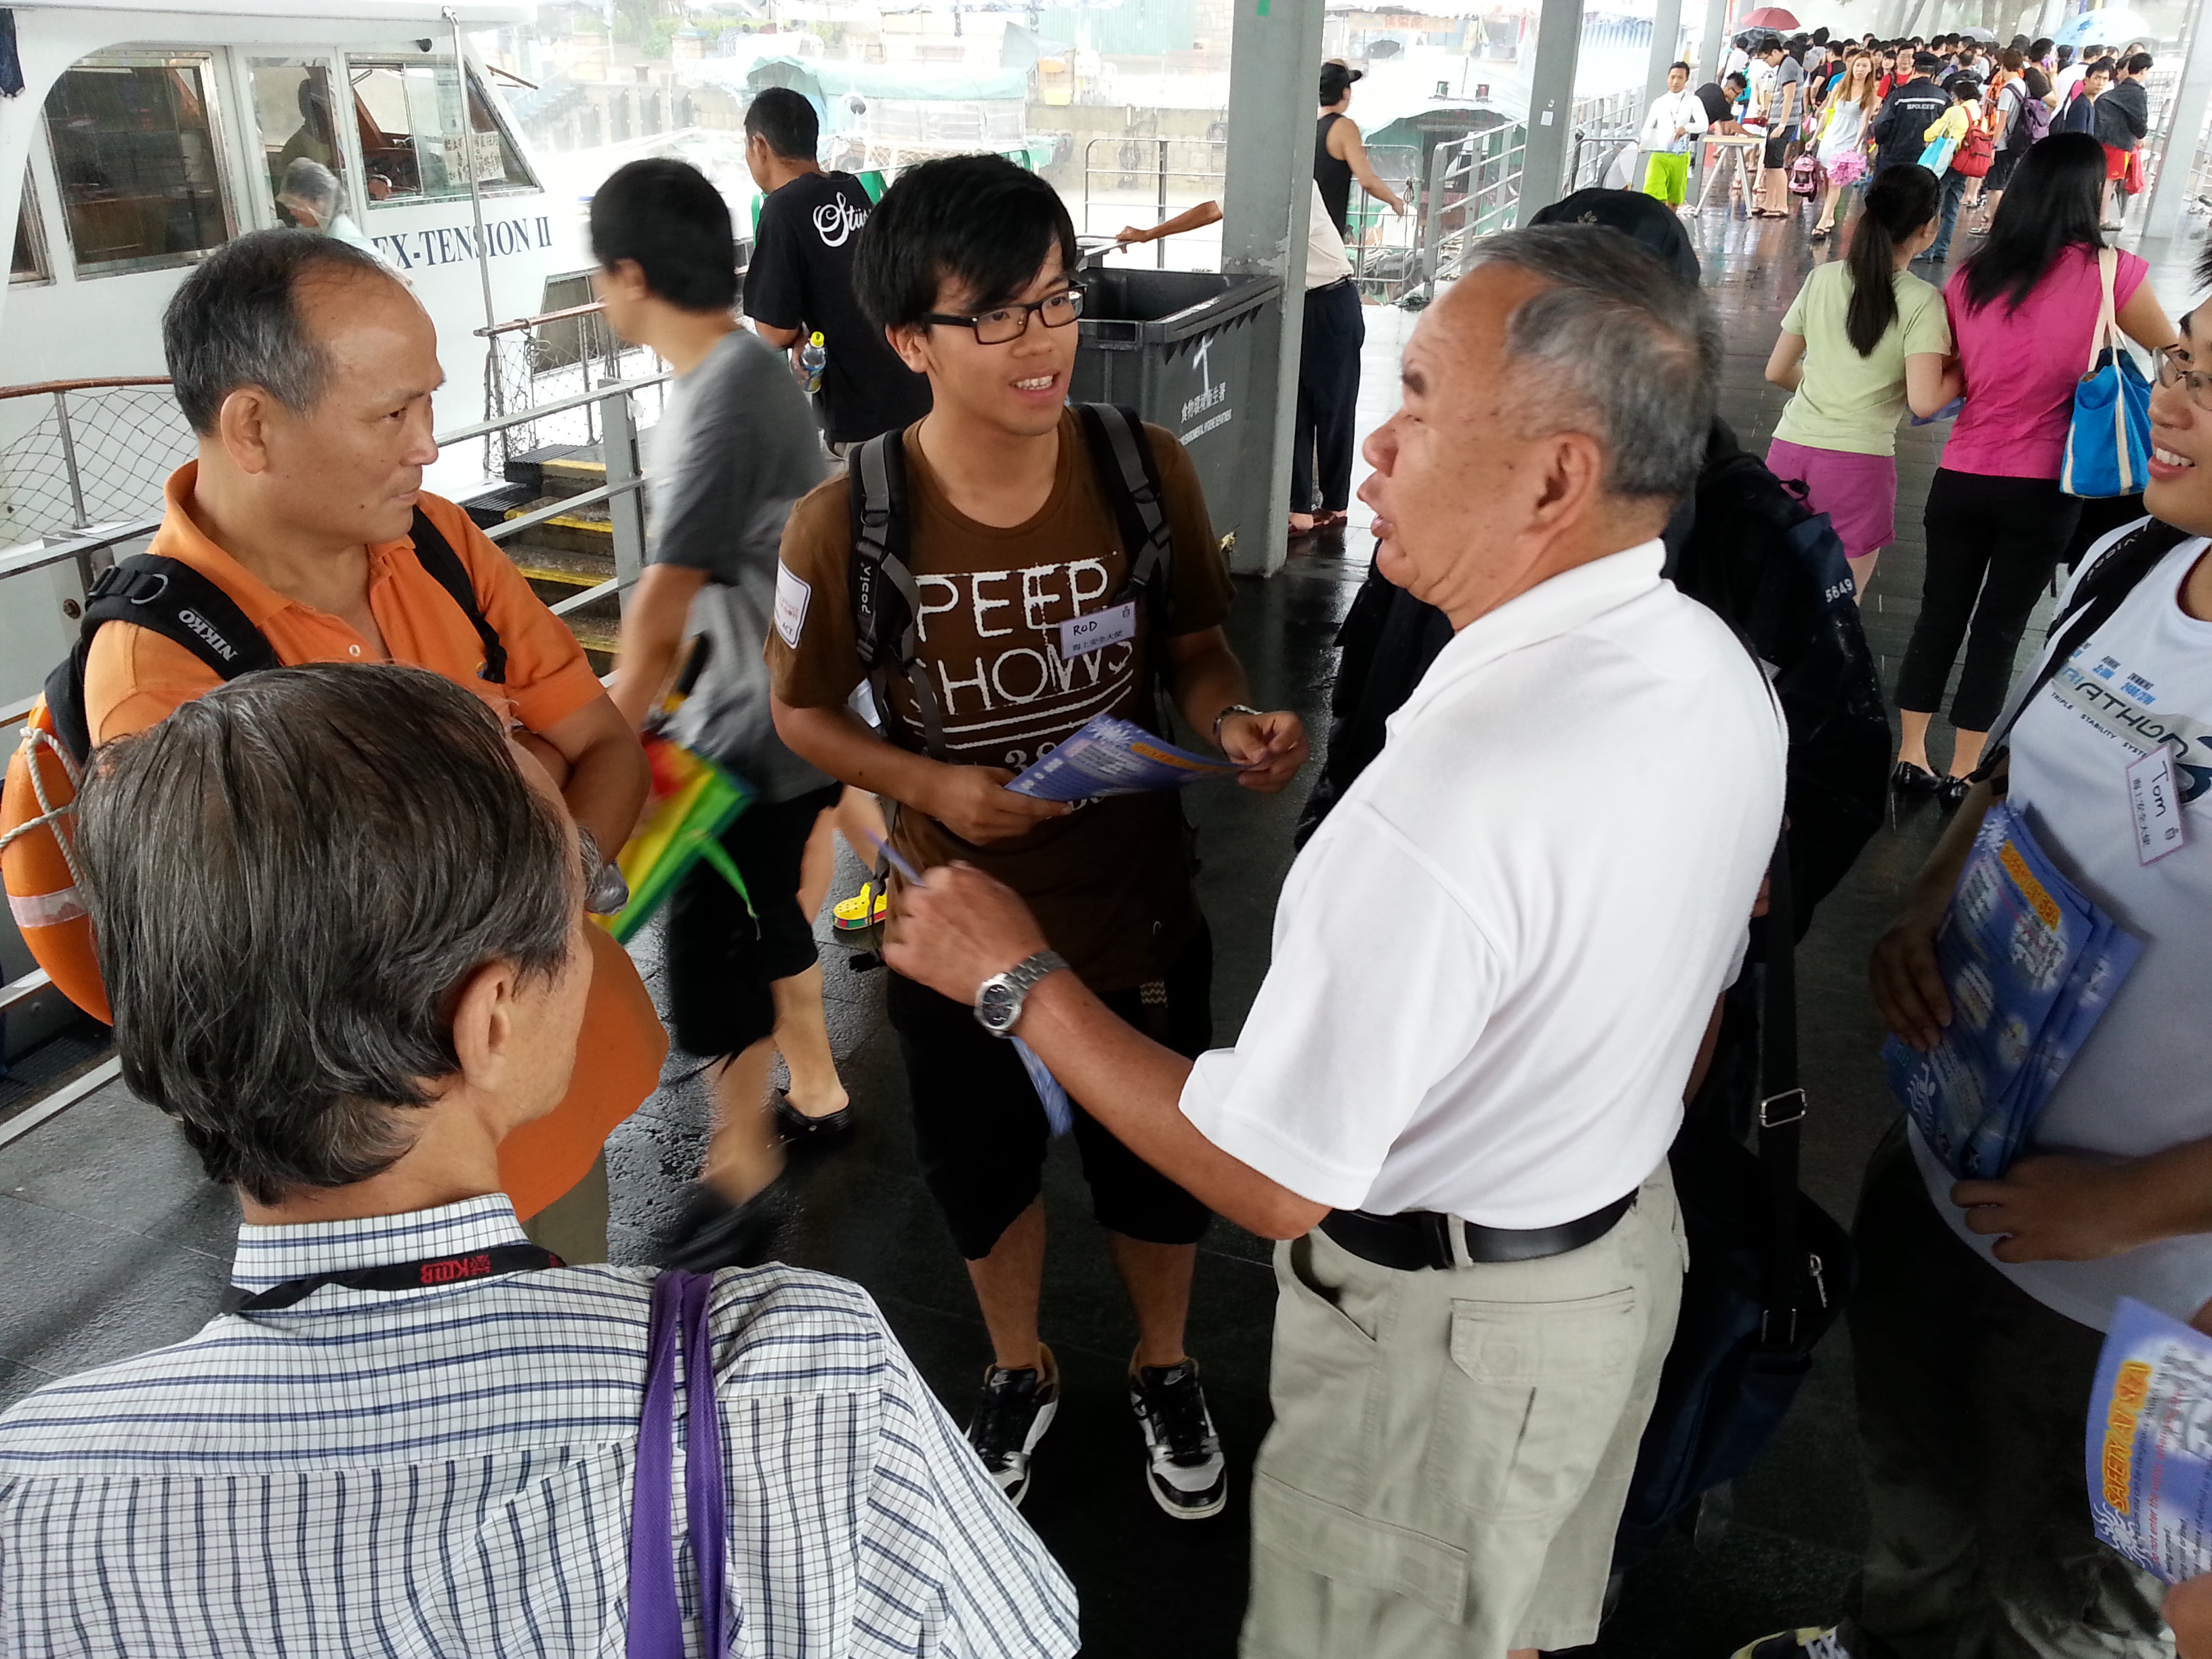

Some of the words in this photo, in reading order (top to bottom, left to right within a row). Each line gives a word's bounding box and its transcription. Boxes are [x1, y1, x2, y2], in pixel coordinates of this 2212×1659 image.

[371, 218, 531, 270] EX-TENION
[535, 216, 552, 248] II
[914, 558, 1108, 642] PEEP
[1825, 578, 1853, 603] 5649
[178, 609, 238, 661] NIKKO
[2051, 692, 2074, 710] TRIPLE
[2080, 714, 2117, 739] STABILITY
[2152, 760, 2169, 818] Tom
[2107, 1435, 2127, 1511] SAFETY
[2148, 1492, 2158, 1509] the
[2149, 1509, 2158, 1535] enter
[2150, 1534, 2158, 1552] not
